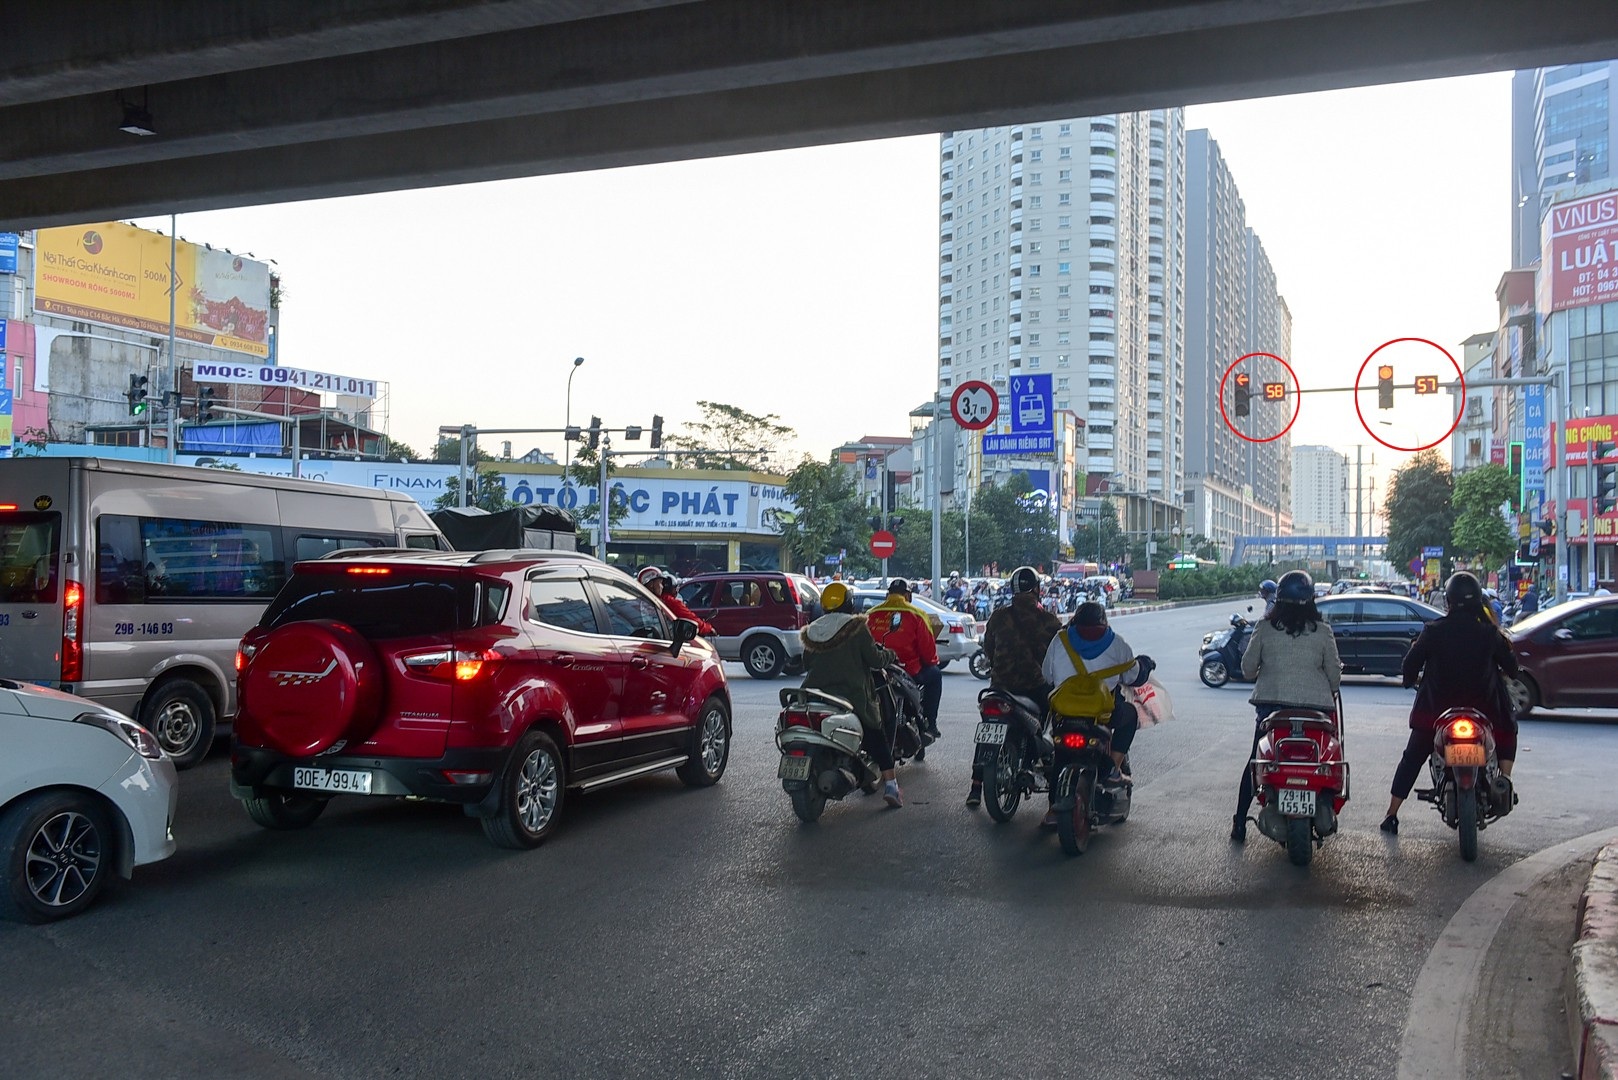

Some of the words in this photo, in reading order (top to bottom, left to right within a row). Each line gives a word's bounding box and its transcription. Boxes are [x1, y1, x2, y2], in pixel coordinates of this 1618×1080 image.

[1556, 199, 1615, 230] VNUS
[144, 269, 167, 284] 500M
[1597, 268, 1609, 280] 04
[42, 274, 87, 288] SHOWROOM
[88, 282, 108, 294] RỘNG
[110, 288, 136, 300] 5000M2
[1573, 284, 1594, 297] HOT:
[197, 364, 253, 378] MQC:
[259, 367, 374, 396] 0941.211.011
[1417, 378, 1436, 392] 57
[1265, 384, 1283, 399] 58
[962, 396, 977, 416] 3,7
[980, 406, 987, 414] m
[1580, 422, 1612, 443] CHỨNG
[986, 437, 999, 451] LÀN
[1000, 436, 1018, 450] DÀNH
[1039, 437, 1051, 449] BRT
[512, 480, 578, 510] ÔTÔ
[662, 486, 739, 516] PHÁT
[115, 623, 134, 635] 29B
[161, 622, 173, 634] 93
[1283, 790, 1311, 802] 29-H1
[1281, 802, 1314, 814] 155.56
